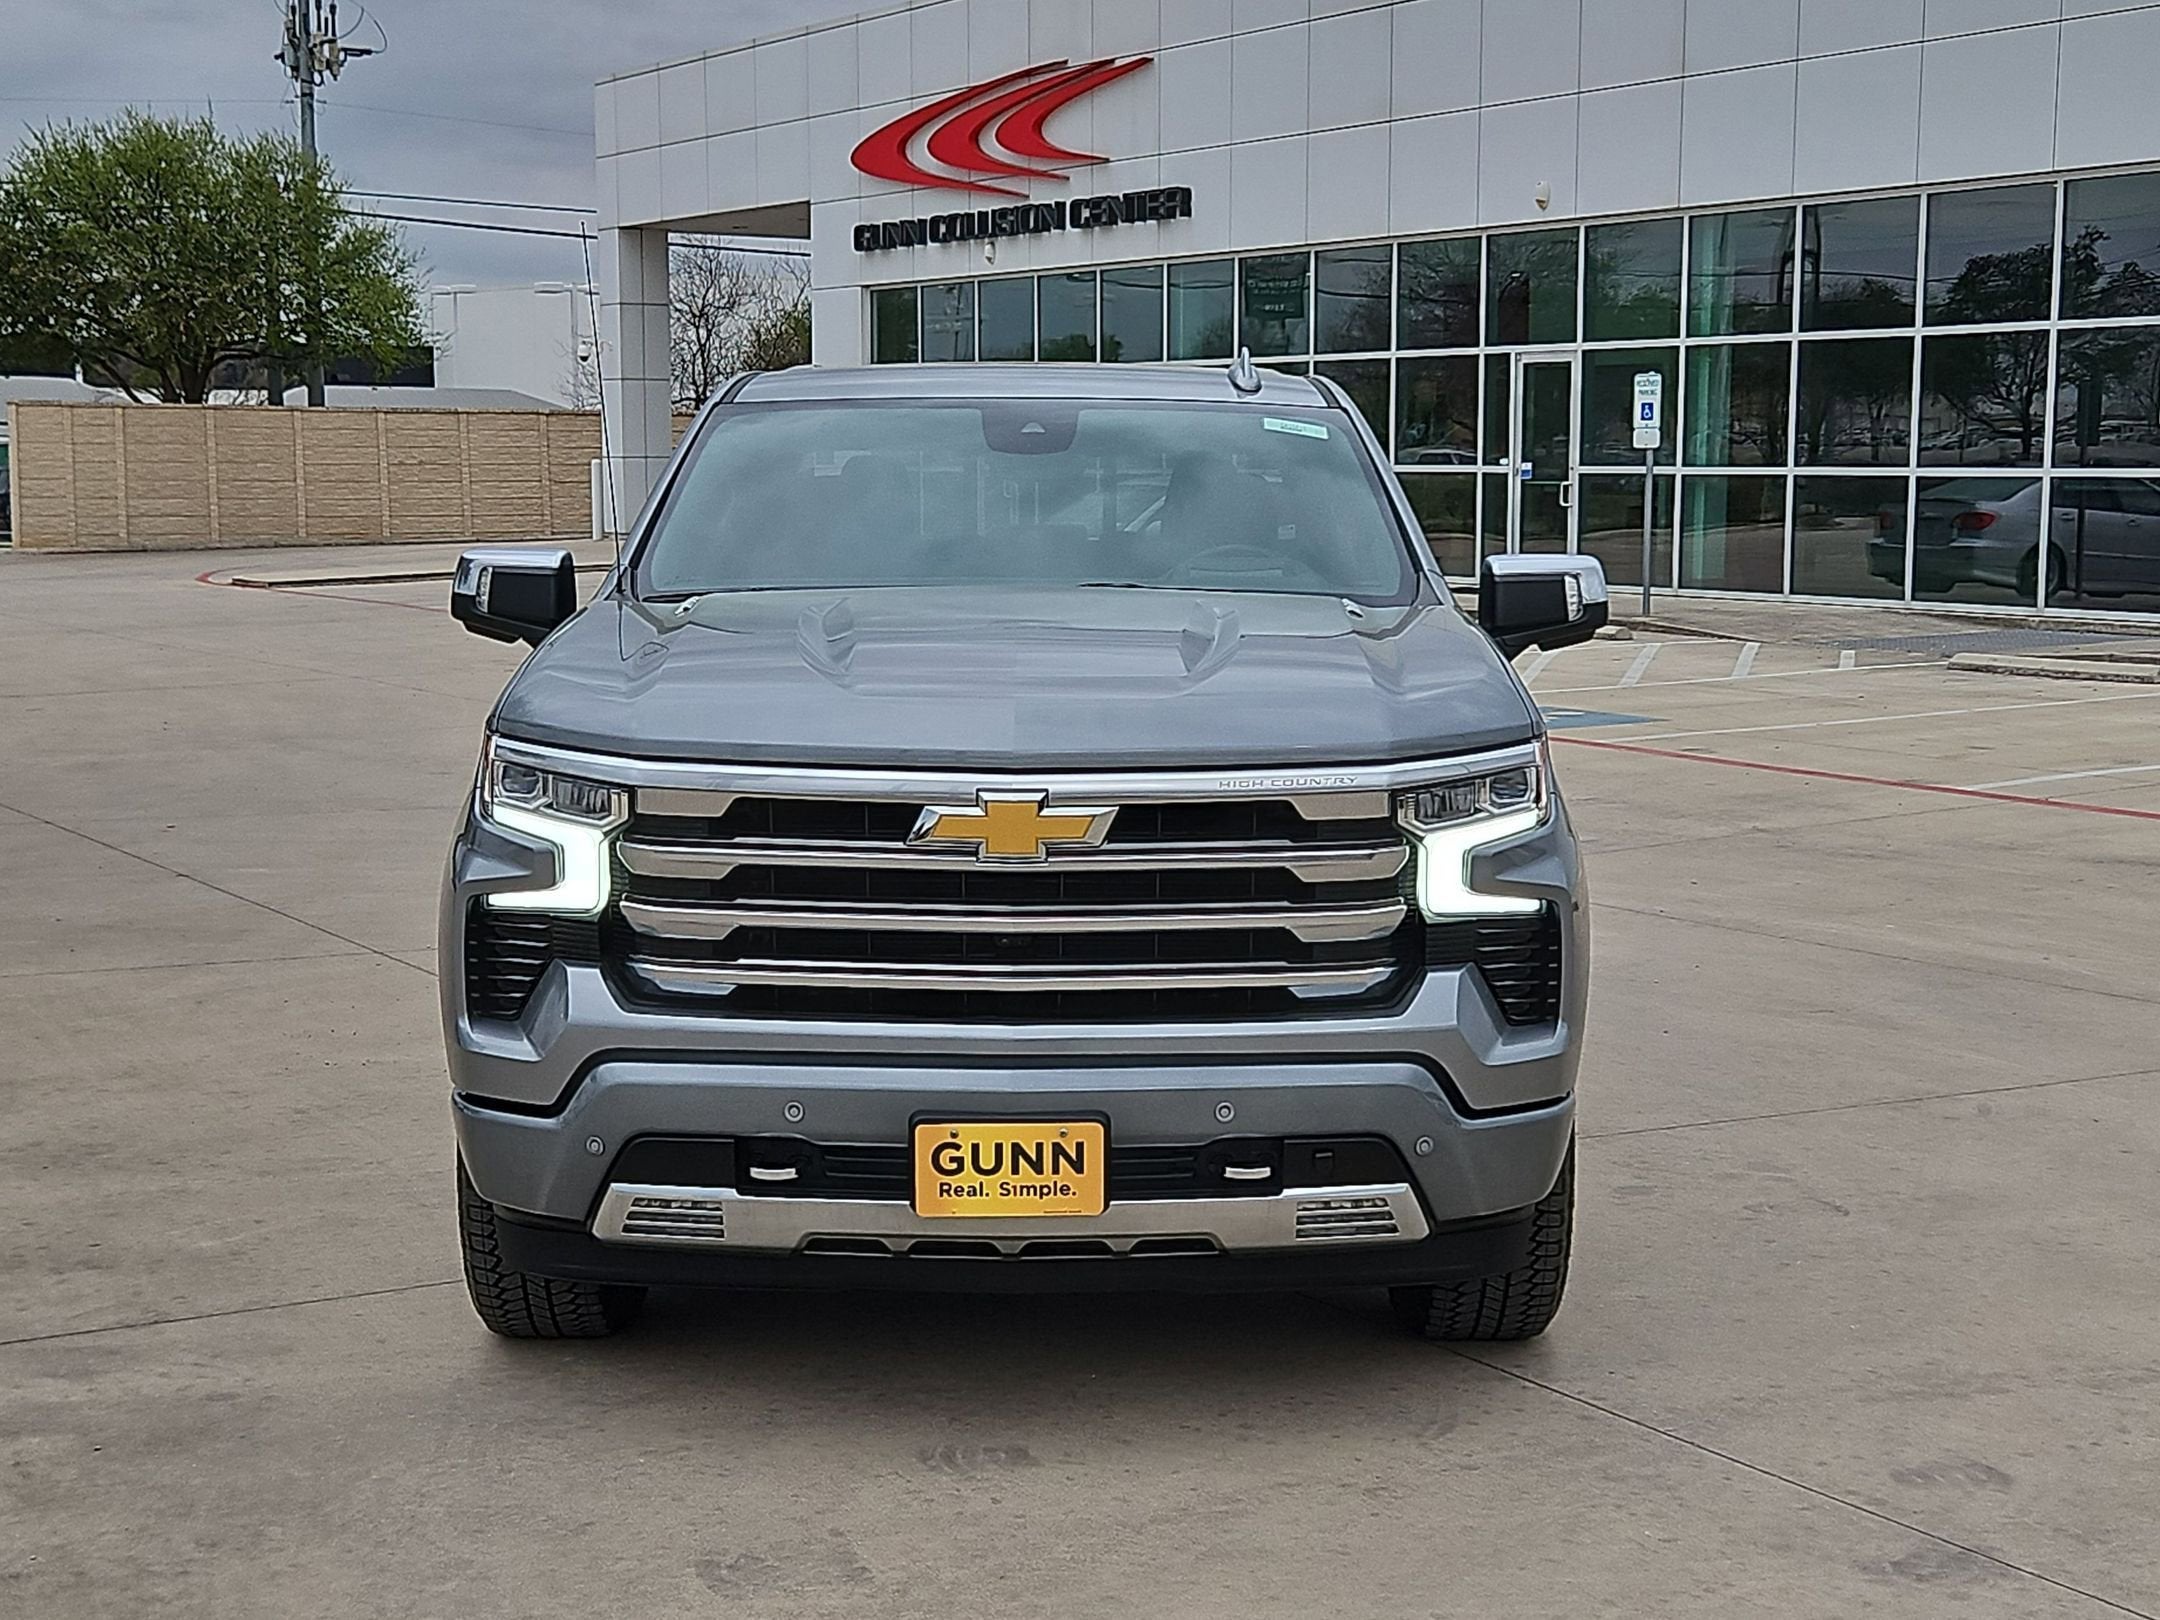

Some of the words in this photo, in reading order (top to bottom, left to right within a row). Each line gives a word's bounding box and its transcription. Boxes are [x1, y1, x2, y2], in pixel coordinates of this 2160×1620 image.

[853, 217, 928, 252] GUNN
[928, 200, 1067, 244] COLLISION
[1069, 186, 1193, 229] CENTER
[1219, 780, 1263, 789] HIGH
[1271, 776, 1358, 787] COUNTRY
[931, 1141, 1084, 1176] GUNN
[939, 1182, 990, 1198] Real.
[999, 1181, 1077, 1200] Simple.
